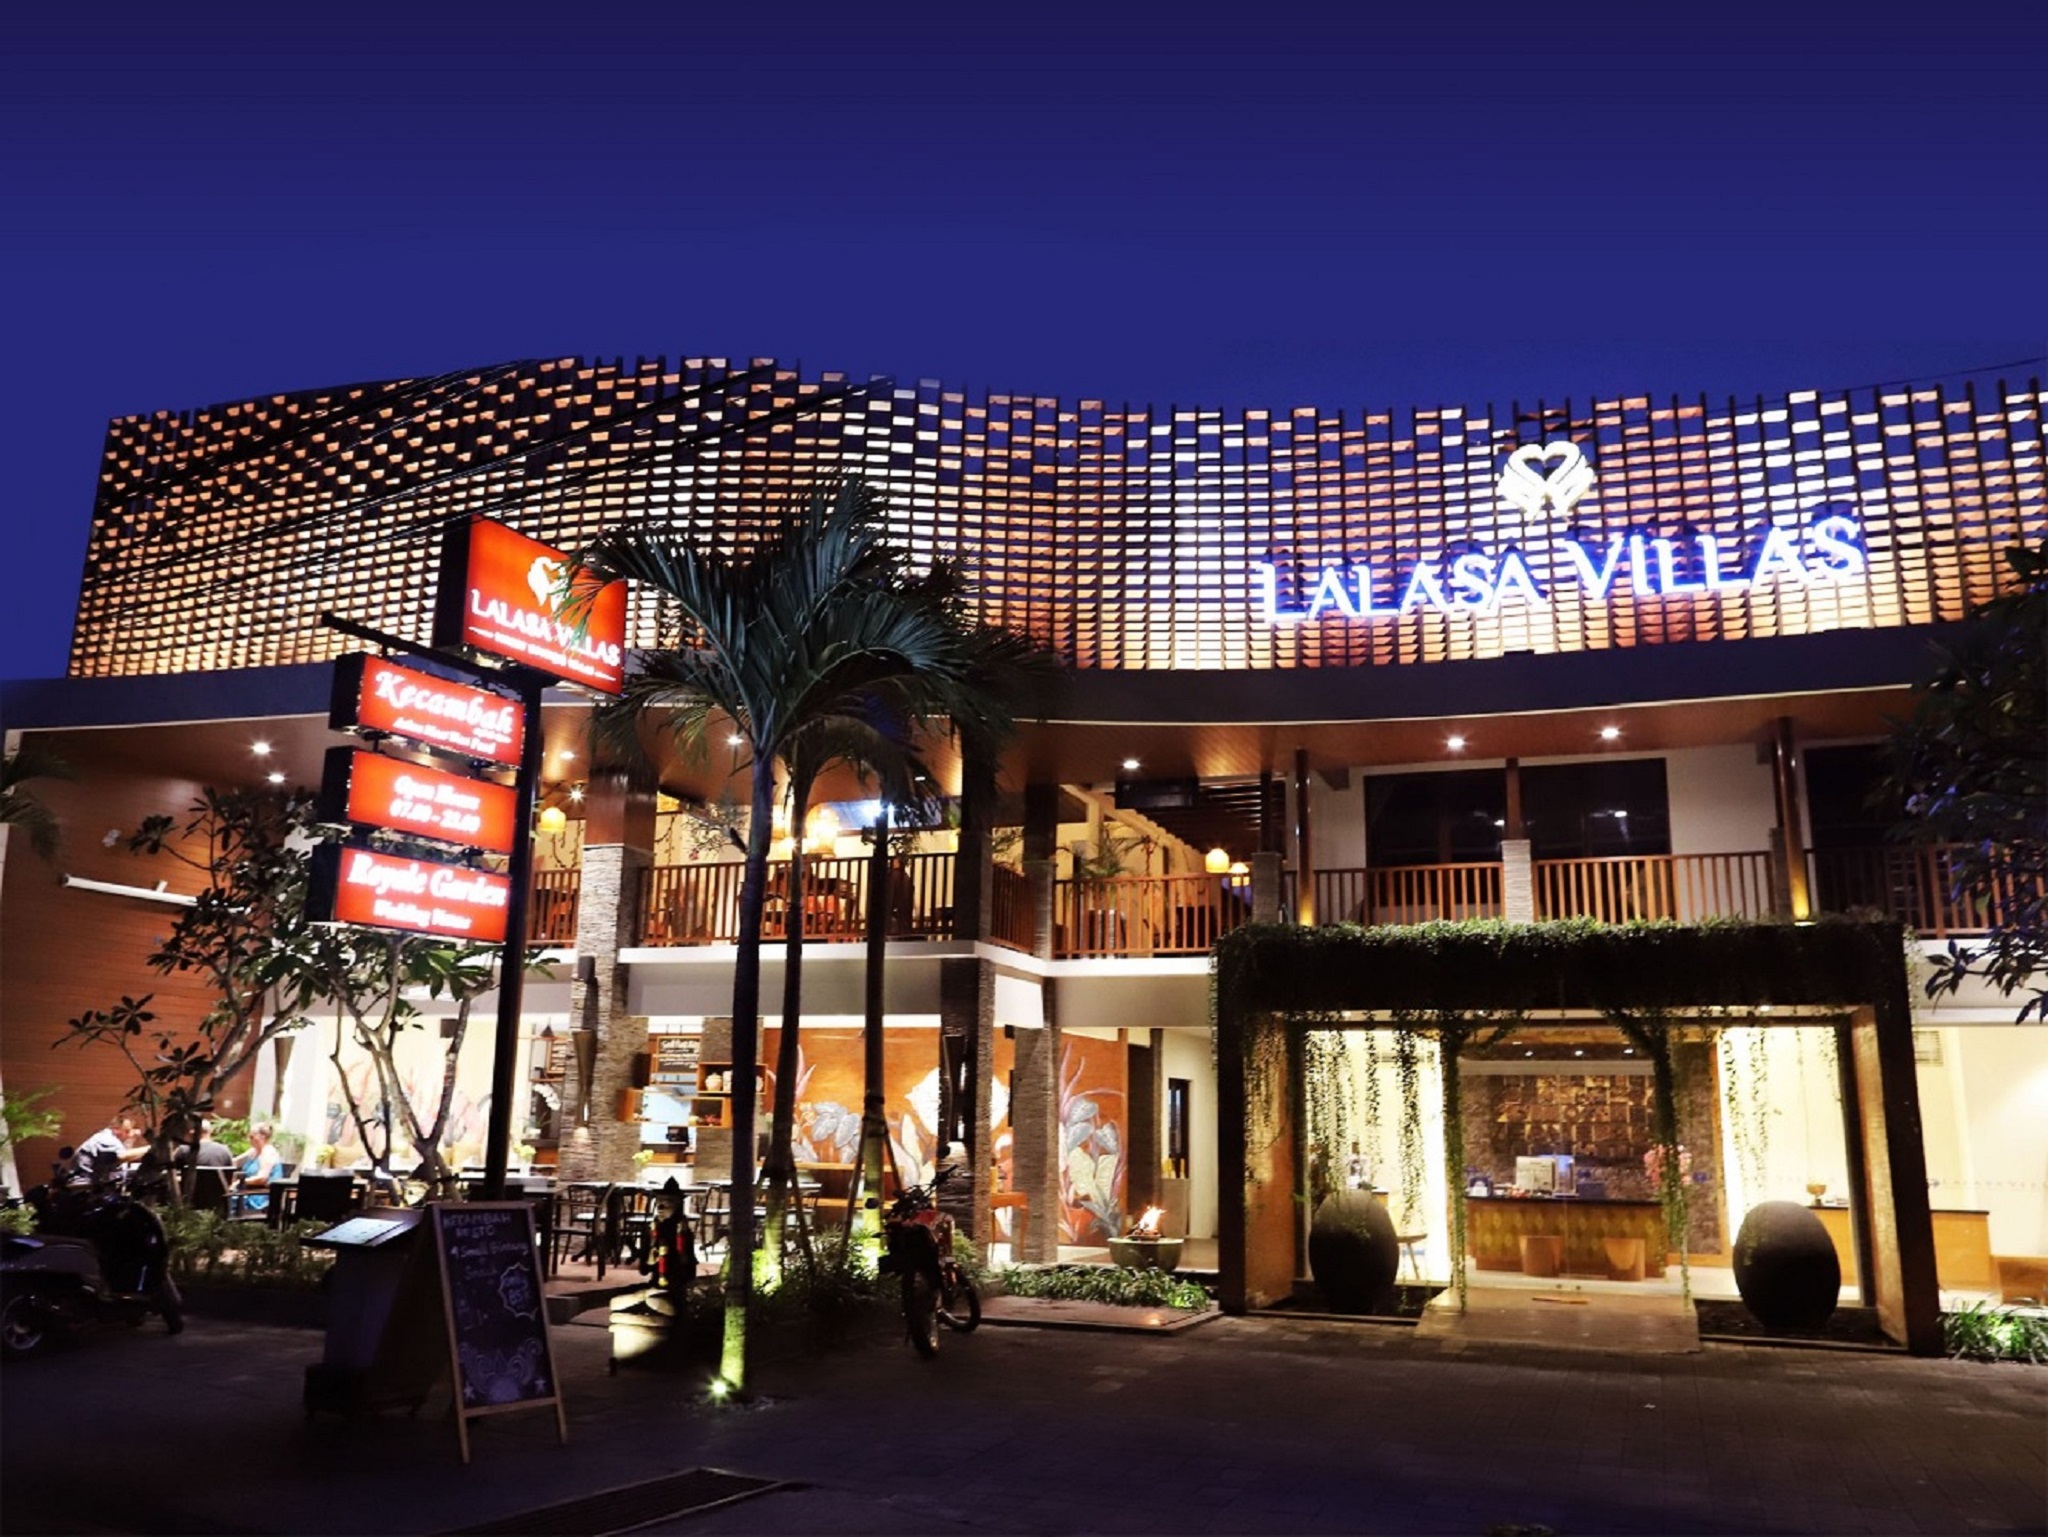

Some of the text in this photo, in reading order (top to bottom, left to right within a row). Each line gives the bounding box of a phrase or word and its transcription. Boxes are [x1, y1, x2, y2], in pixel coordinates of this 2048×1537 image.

[1256, 514, 1865, 622] LALASA VILLAS
[471, 588, 552, 642] LALASA
[375, 671, 514, 734] Kecambah
[430, 868, 508, 907] Garden
